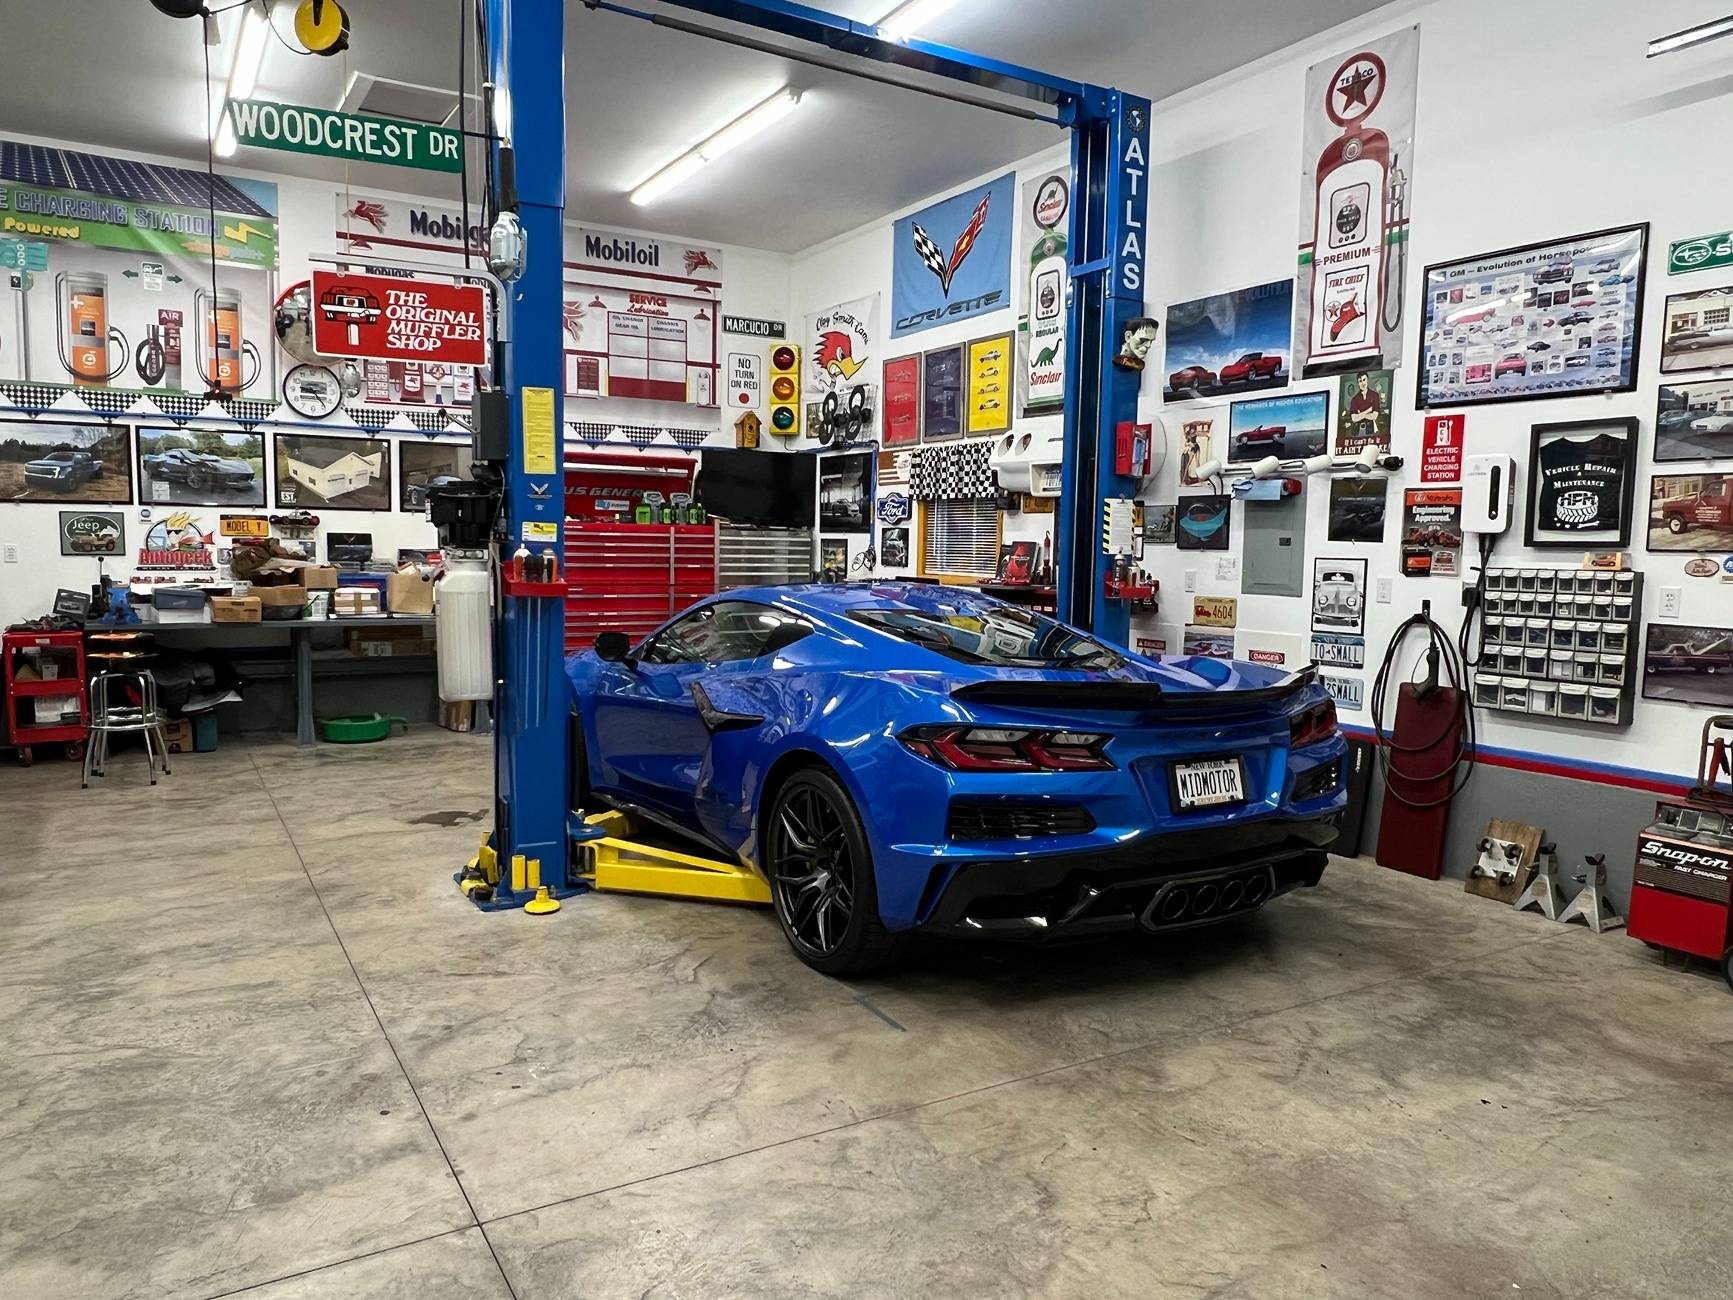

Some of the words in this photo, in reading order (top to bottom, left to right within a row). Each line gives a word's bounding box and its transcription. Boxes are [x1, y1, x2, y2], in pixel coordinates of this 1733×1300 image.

[232, 98, 418, 160] WOODCREST
[429, 131, 459, 160] DR
[14, 190, 129, 225] CHARGING
[134, 207, 221, 238] STATION
[1122, 137, 1145, 290] ATLAS
[4, 217, 80, 238] Powered
[585, 235, 660, 267] Mobiloil
[1323, 247, 1371, 265] PREMIUM
[1449, 268, 1466, 278] GM
[1477, 258, 1524, 273] Evolution
[1526, 256, 1536, 264] of
[1328, 277, 1344, 288] FIRE
[385, 290, 427, 307] THE
[160, 311, 180, 320] AIR
[386, 306, 479, 327] ORIGINAL
[895, 290, 1003, 330] CORVETTE
[726, 317, 769, 335] MARCUCIO
[833, 311, 854, 327] Smith
[387, 321, 481, 341] MUFFLER
[1036, 326, 1059, 337] REGULAR
[386, 335, 441, 351] SHOP
[738, 358, 751, 369] NO
[735, 369, 755, 379] TURN
[1030, 371, 1062, 386] Sinclair
[730, 380, 742, 388] ON
[743, 381, 758, 389] RED
[1426, 447, 1459, 455] ELECTRIC
[882, 502, 904, 516] Ford
[1412, 505, 1455, 516] Engineering
[72, 521, 100, 531] Jeep
[226, 521, 251, 532] MODEL
[257, 521, 262, 531] Y
[138, 549, 213, 567] Autogeek
[1213, 605, 1233, 619] 4604
[1254, 653, 1280, 661] DANGER
[1191, 762, 1206, 770] NEW
[1208, 760, 1224, 769] YORK
[1180, 769, 1237, 798] MIDMOTOR
[1641, 841, 1731, 869] Snap-on
